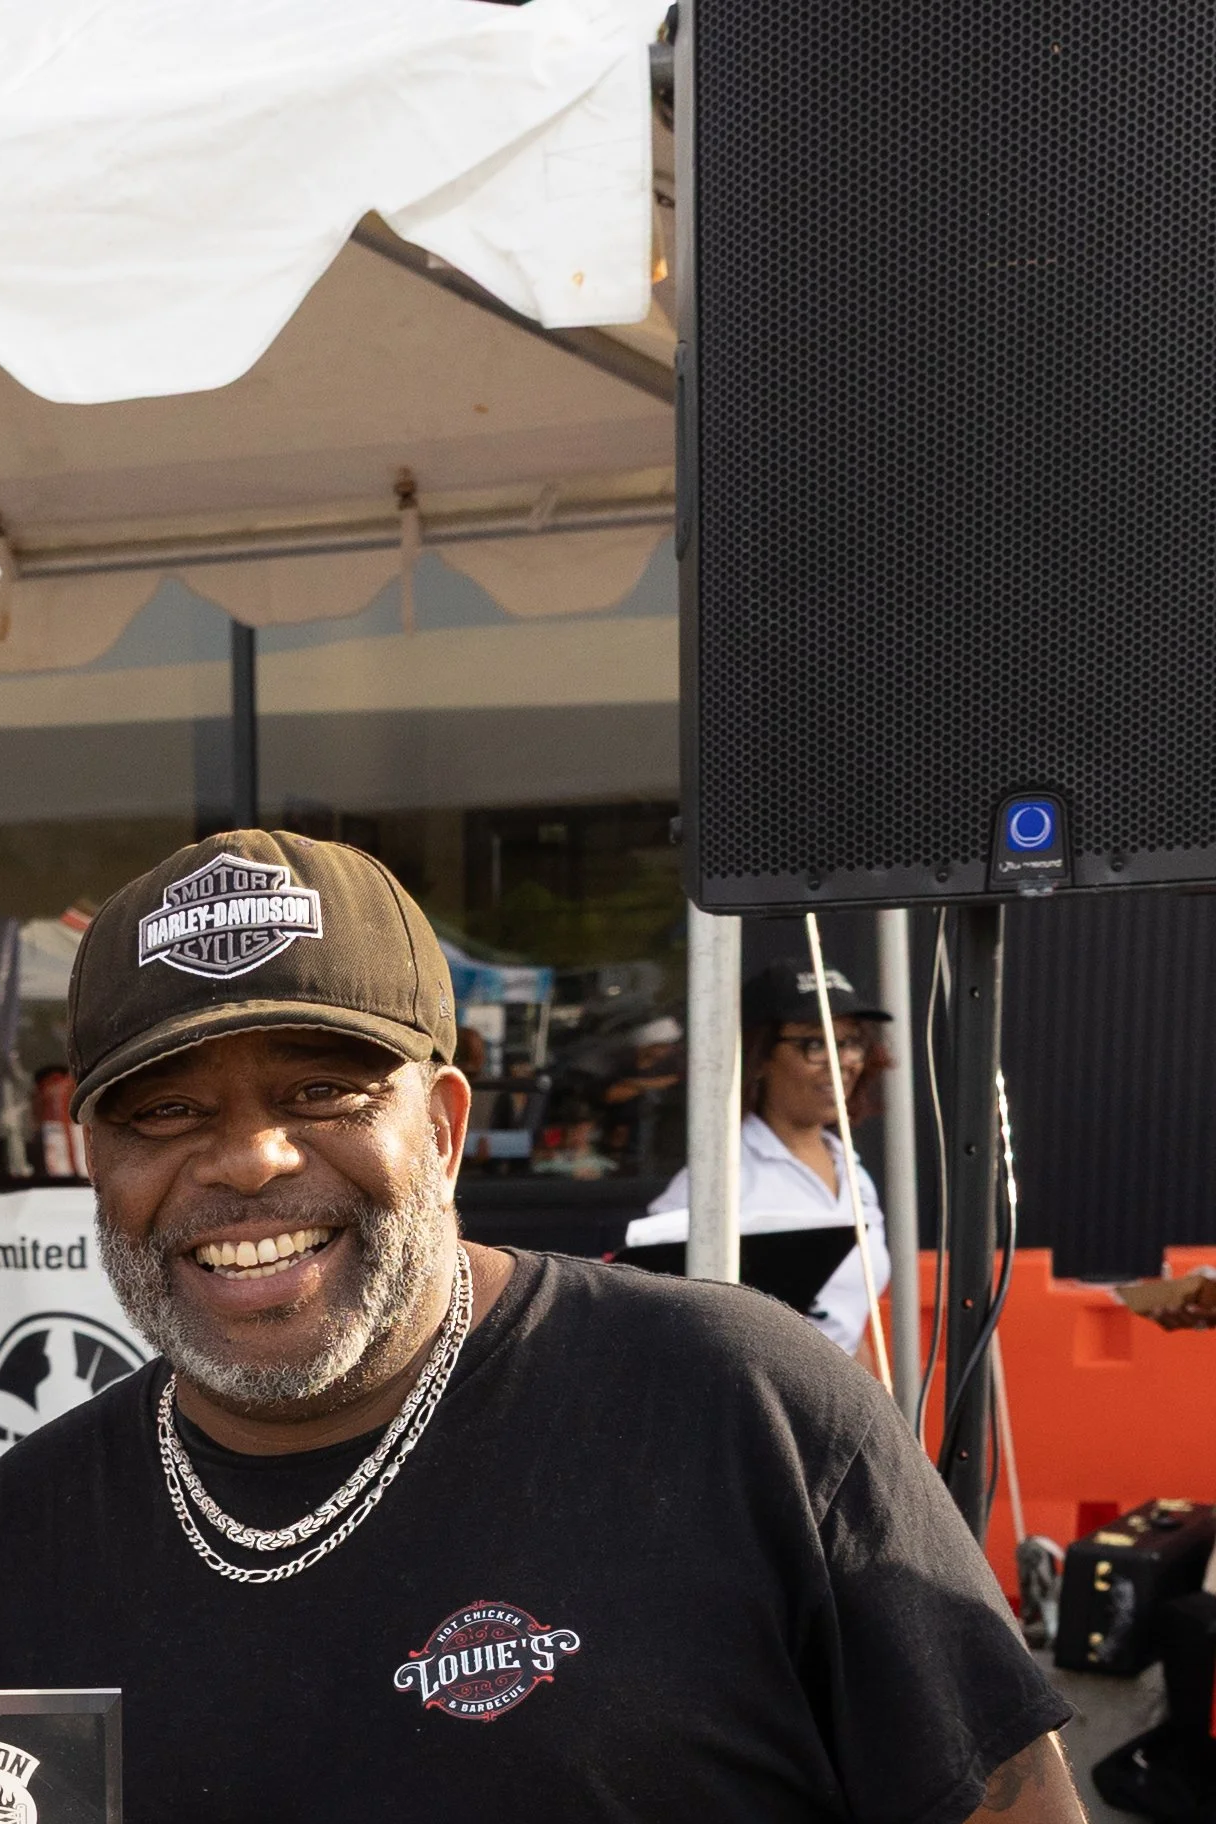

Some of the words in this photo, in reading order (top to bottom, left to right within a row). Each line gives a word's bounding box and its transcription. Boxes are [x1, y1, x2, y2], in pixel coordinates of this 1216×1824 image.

[182, 867, 268, 900] MOTOR
[147, 897, 311, 949] HARLEY-DAVIDSON
[184, 931, 270, 965] CYCLES
[436, 1620, 458, 1643] HOT
[464, 1609, 521, 1627] CHICKEN
[393, 1629, 581, 1703] LOUIE'S
[448, 1700, 457, 1709] &
[460, 1684, 526, 1713] BARBECUE
